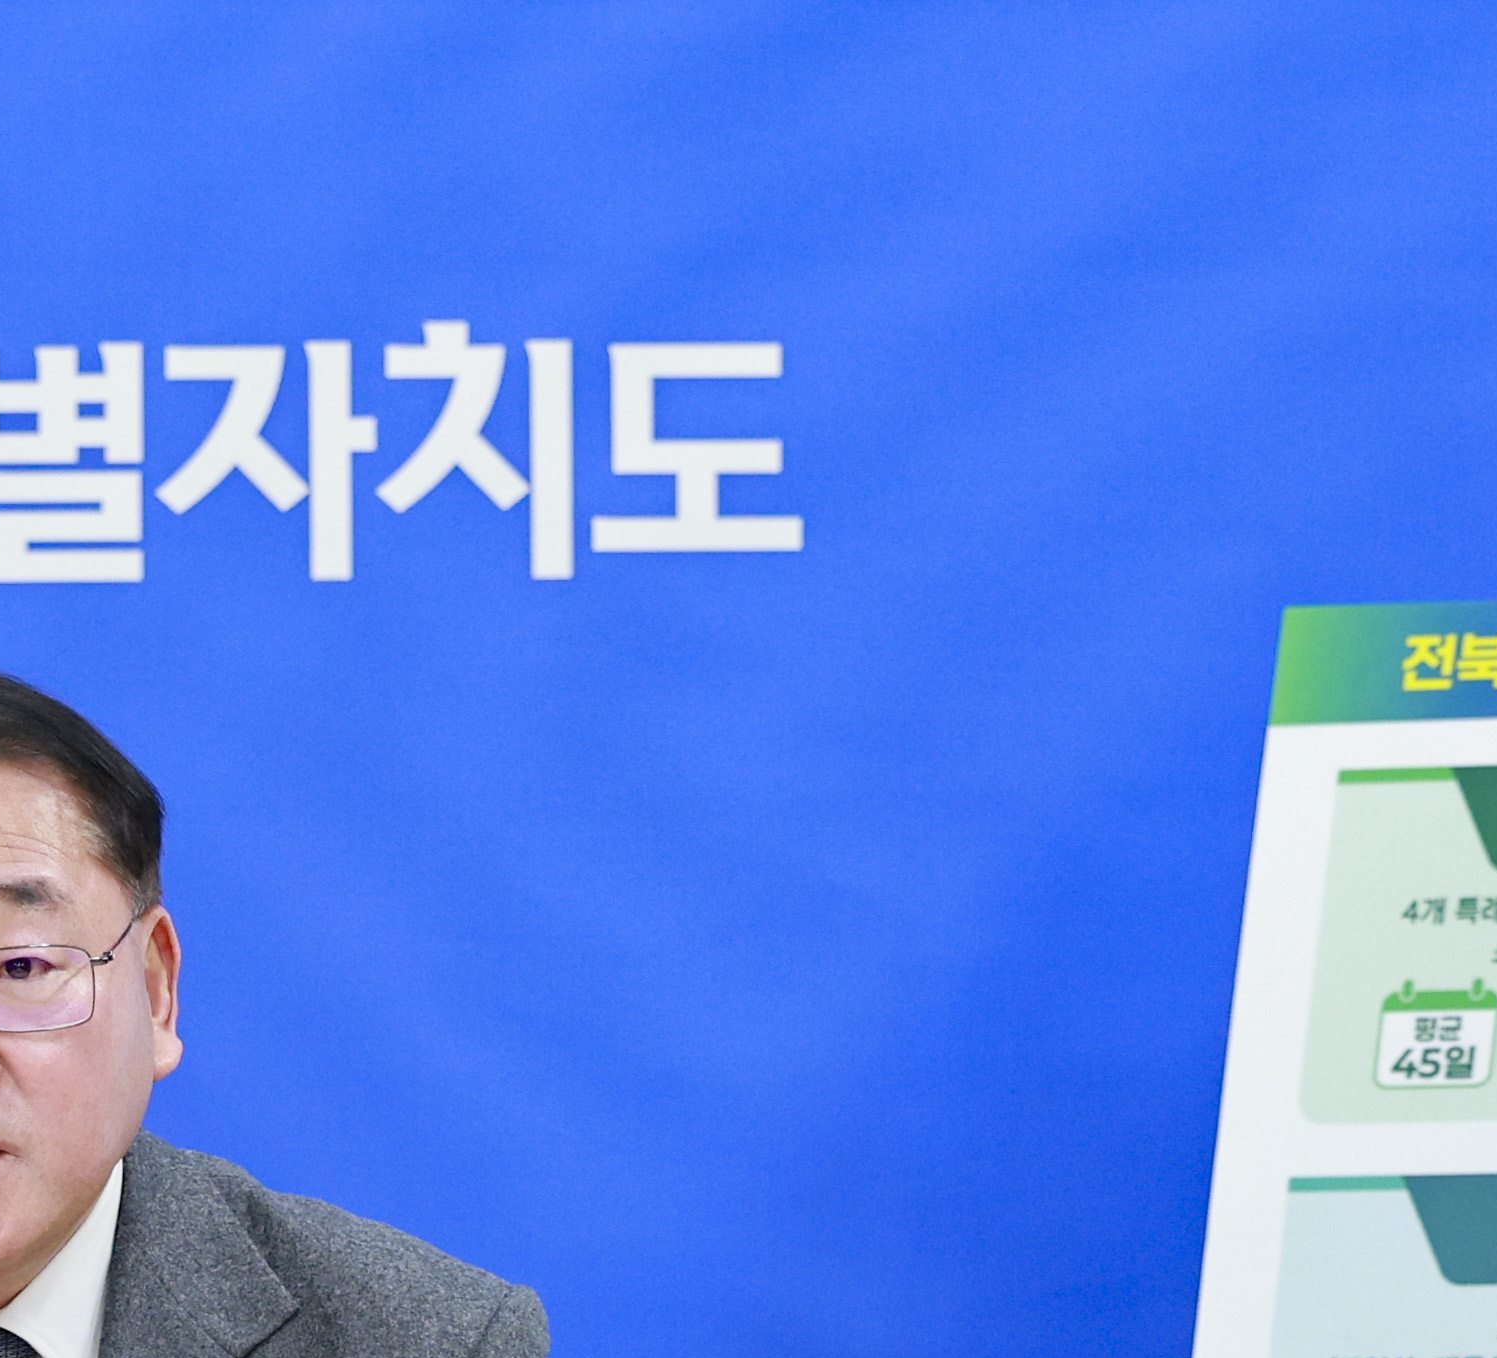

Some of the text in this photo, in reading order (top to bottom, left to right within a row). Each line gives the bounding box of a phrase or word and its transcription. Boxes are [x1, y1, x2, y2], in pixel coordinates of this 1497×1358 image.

[1402, 896, 1446, 925] 4개
[1413, 1016, 1464, 1043] 평균
[1391, 1046, 1477, 1081] 45일
